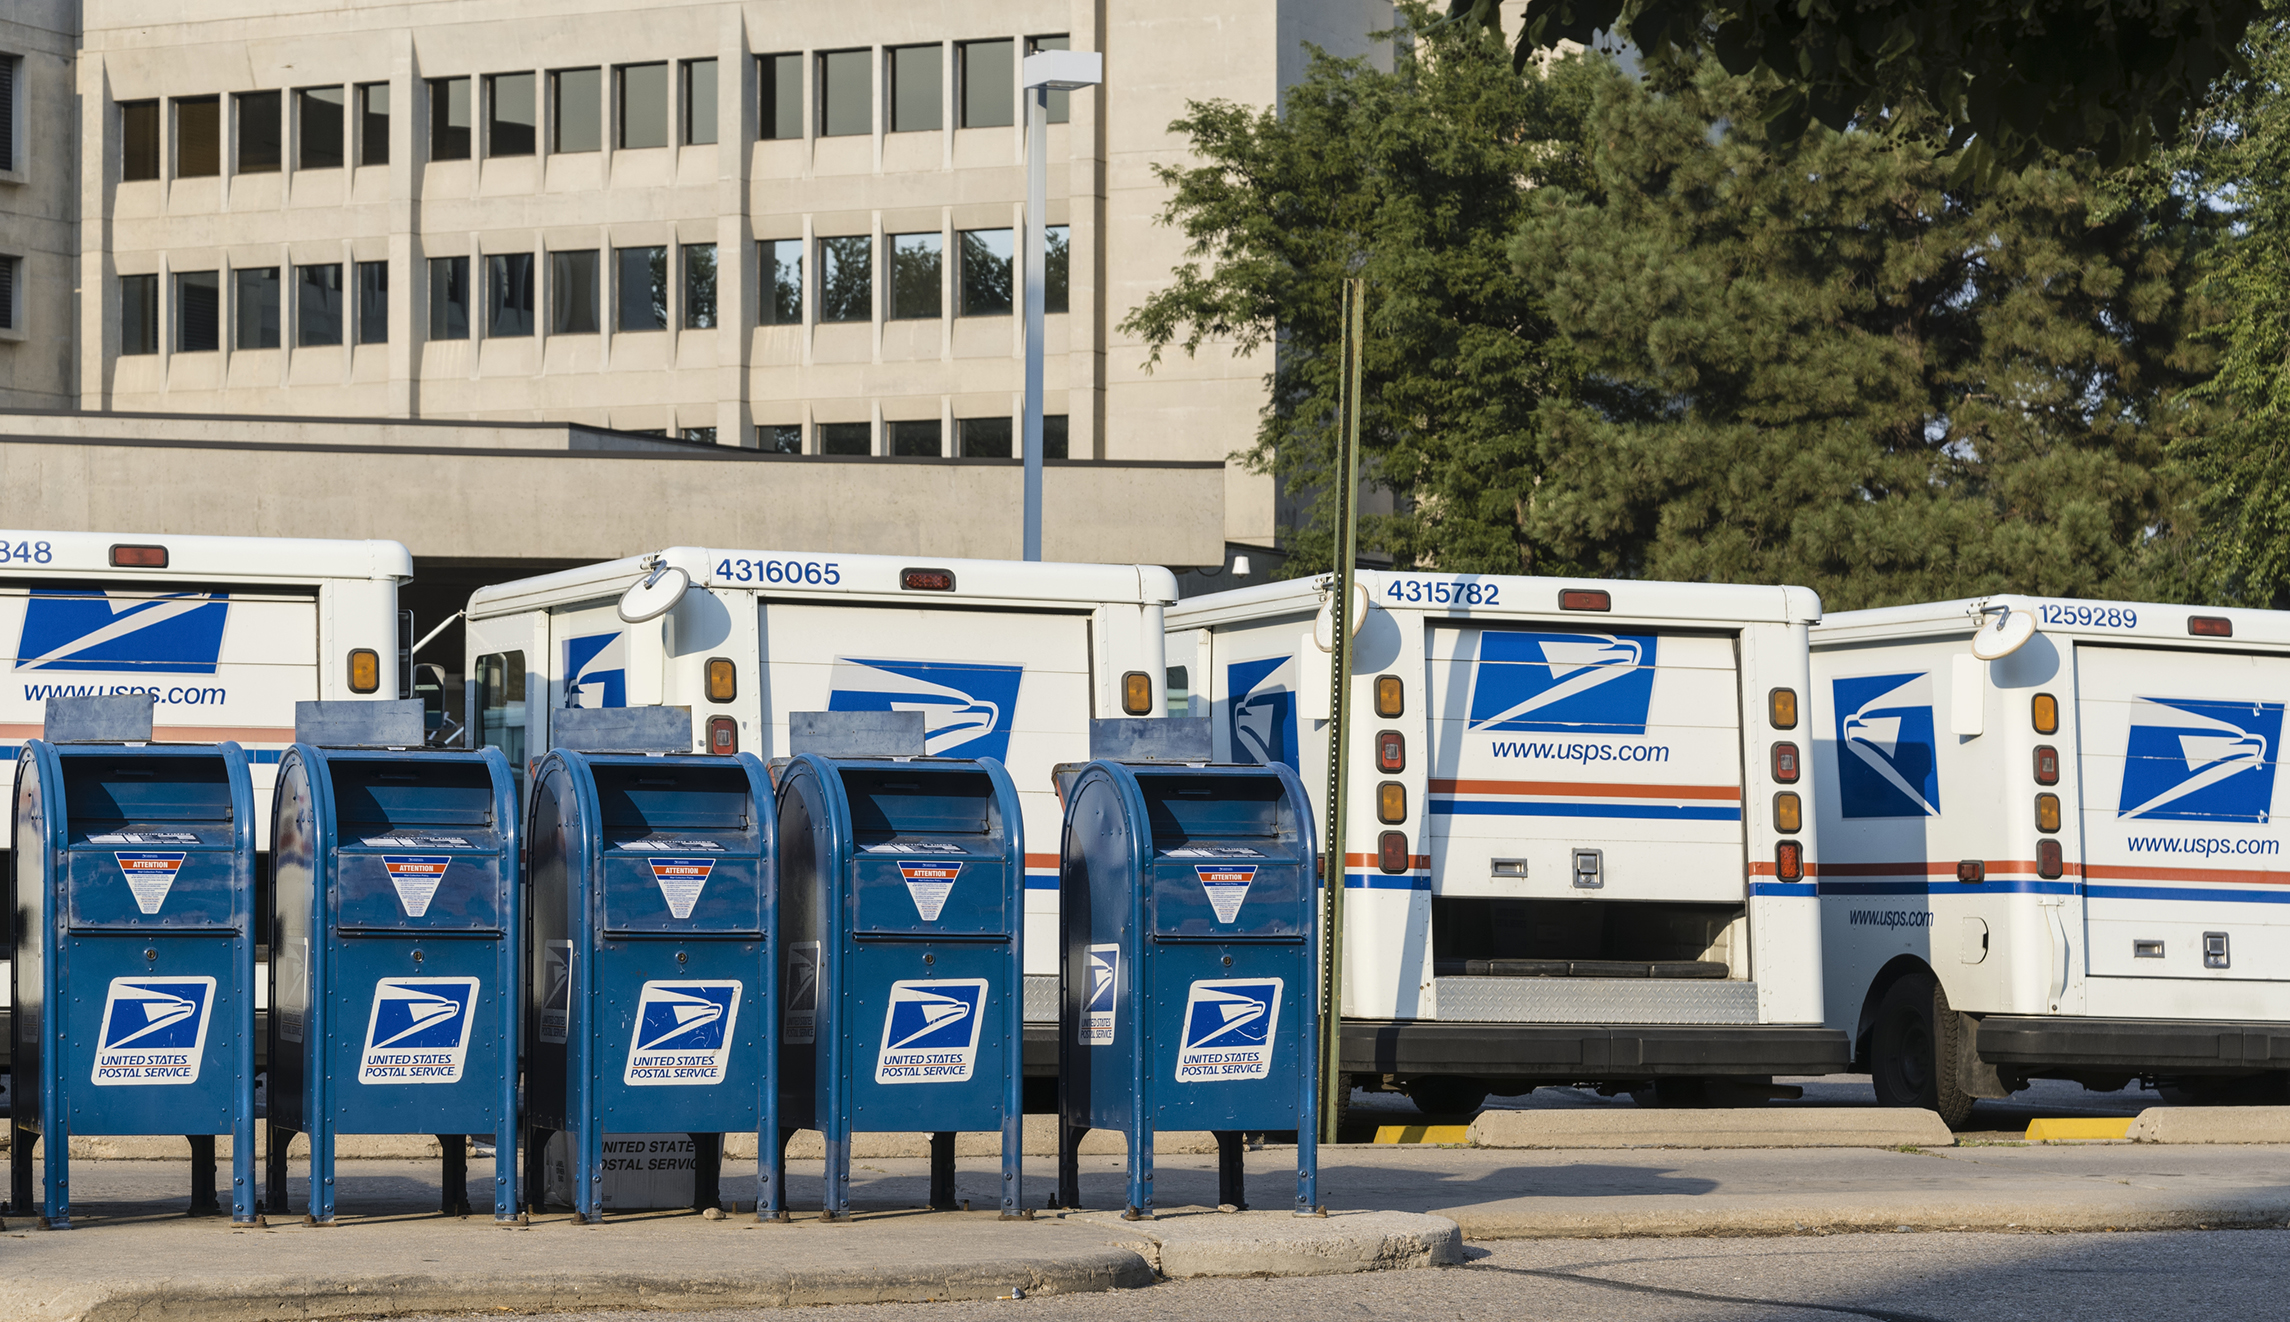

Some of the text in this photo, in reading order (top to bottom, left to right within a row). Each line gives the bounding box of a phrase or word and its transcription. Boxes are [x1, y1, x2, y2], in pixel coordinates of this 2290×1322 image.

[716, 558, 840, 585] 4316065
[1387, 580, 1500, 605] 4315782
[2039, 604, 2137, 629] 1259289
[1492, 741, 1670, 765] www.usps.com
[2127, 837, 2279, 858] www.usps.com
[132, 861, 169, 869] ATTENTION
[1210, 873, 1243, 881] ATTENTION
[1849, 910, 1934, 931] www.usps.com
[101, 1055, 188, 1065] UNITED STATES
[367, 1054, 452, 1065] UNITED STATES
[633, 1056, 715, 1066] UNITED STATES
[883, 1054, 963, 1065] UNITED STATES
[1183, 1052, 1260, 1064] UNITED STATES
[98, 1067, 191, 1078] POSTAL SERVICE
[365, 1066, 455, 1077] POSTAL SERVICE
[630, 1068, 718, 1079] POSTAL SERVICE
[881, 1065, 966, 1077] POSTAL SERVICE
[1181, 1063, 1263, 1076] POSTAL SERVICE
[602, 1141, 646, 1153] NITED
